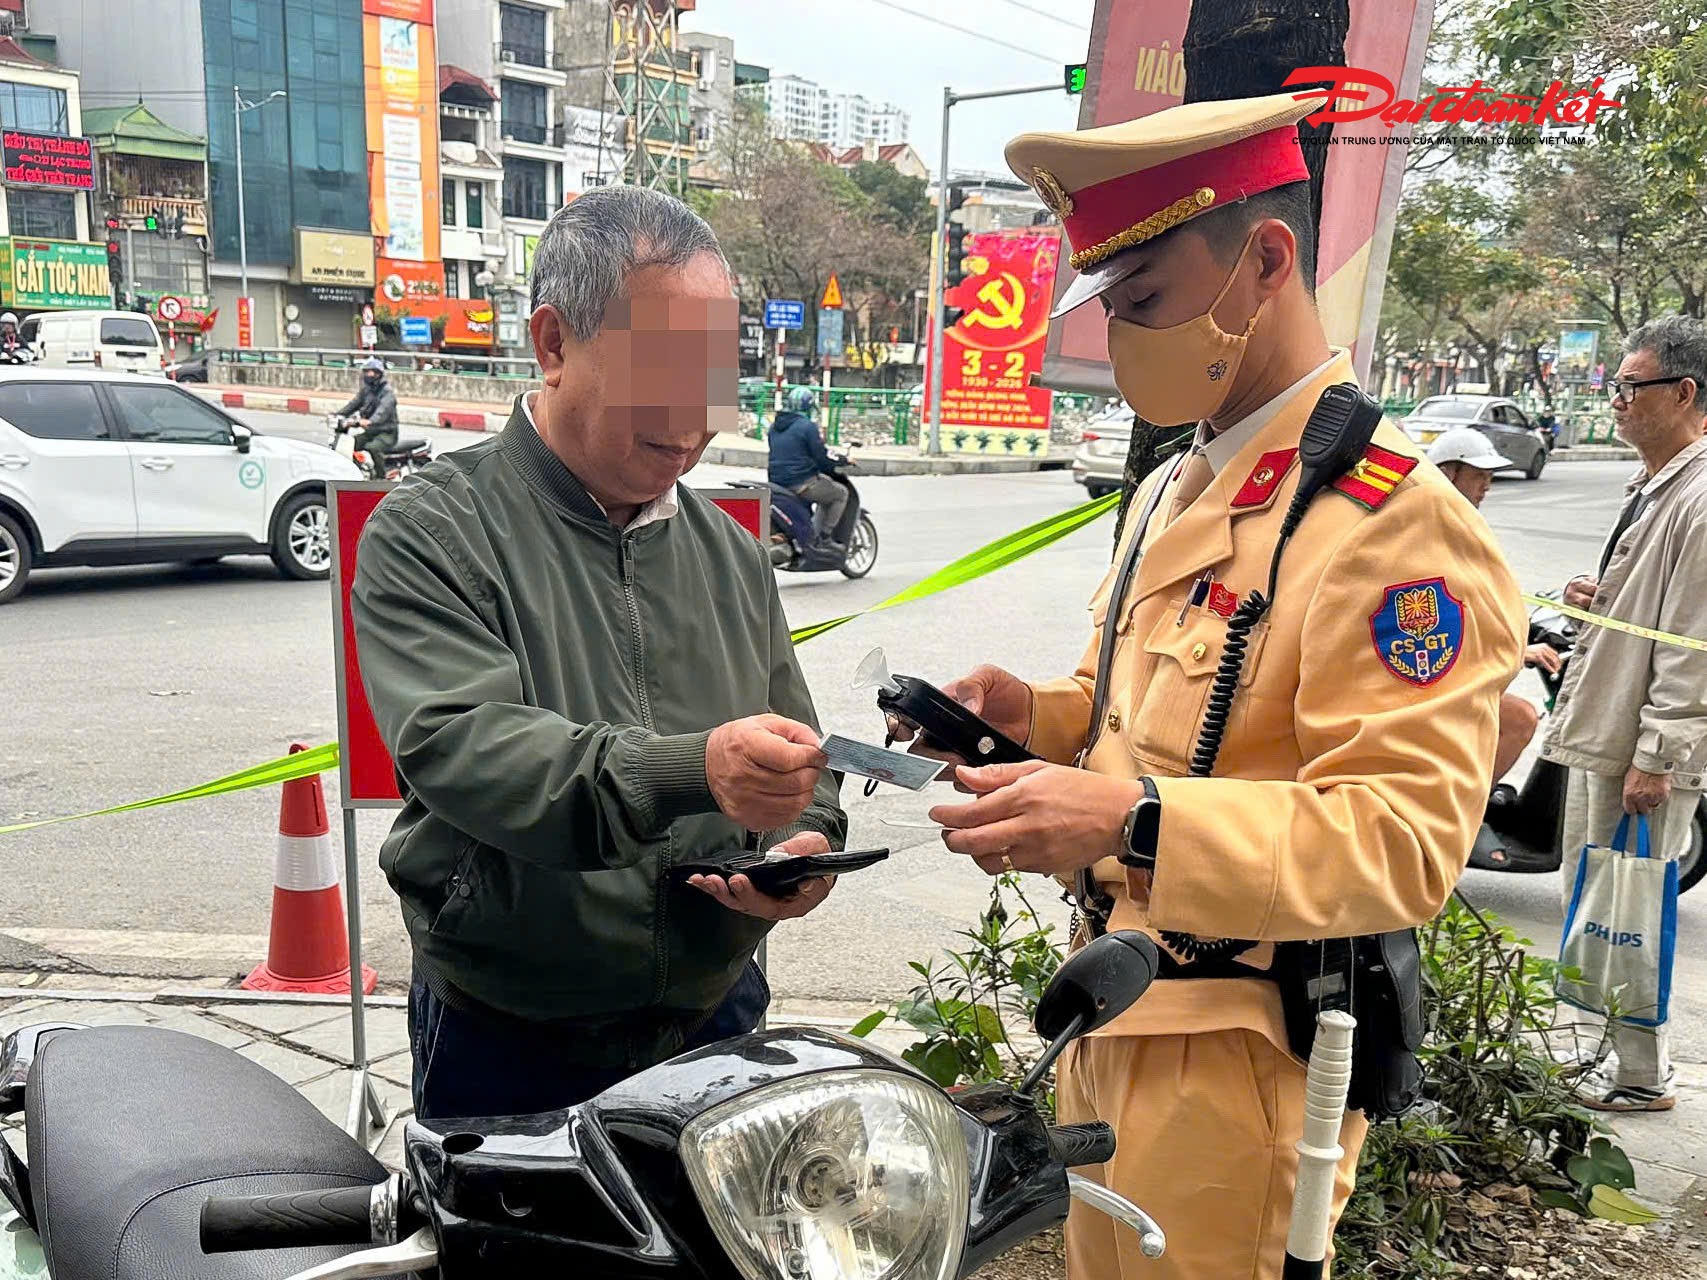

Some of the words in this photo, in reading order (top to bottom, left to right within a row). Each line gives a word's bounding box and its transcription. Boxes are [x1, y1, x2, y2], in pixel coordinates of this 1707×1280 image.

[16, 248, 45, 293] CẮT
[47, 254, 76, 295] TÓC
[77, 263, 110, 296] NAM
[961, 349, 982, 376] 3
[1004, 351, 1025, 377] 2
[1390, 639, 1416, 655] CS
[1425, 633, 1449, 650] GT
